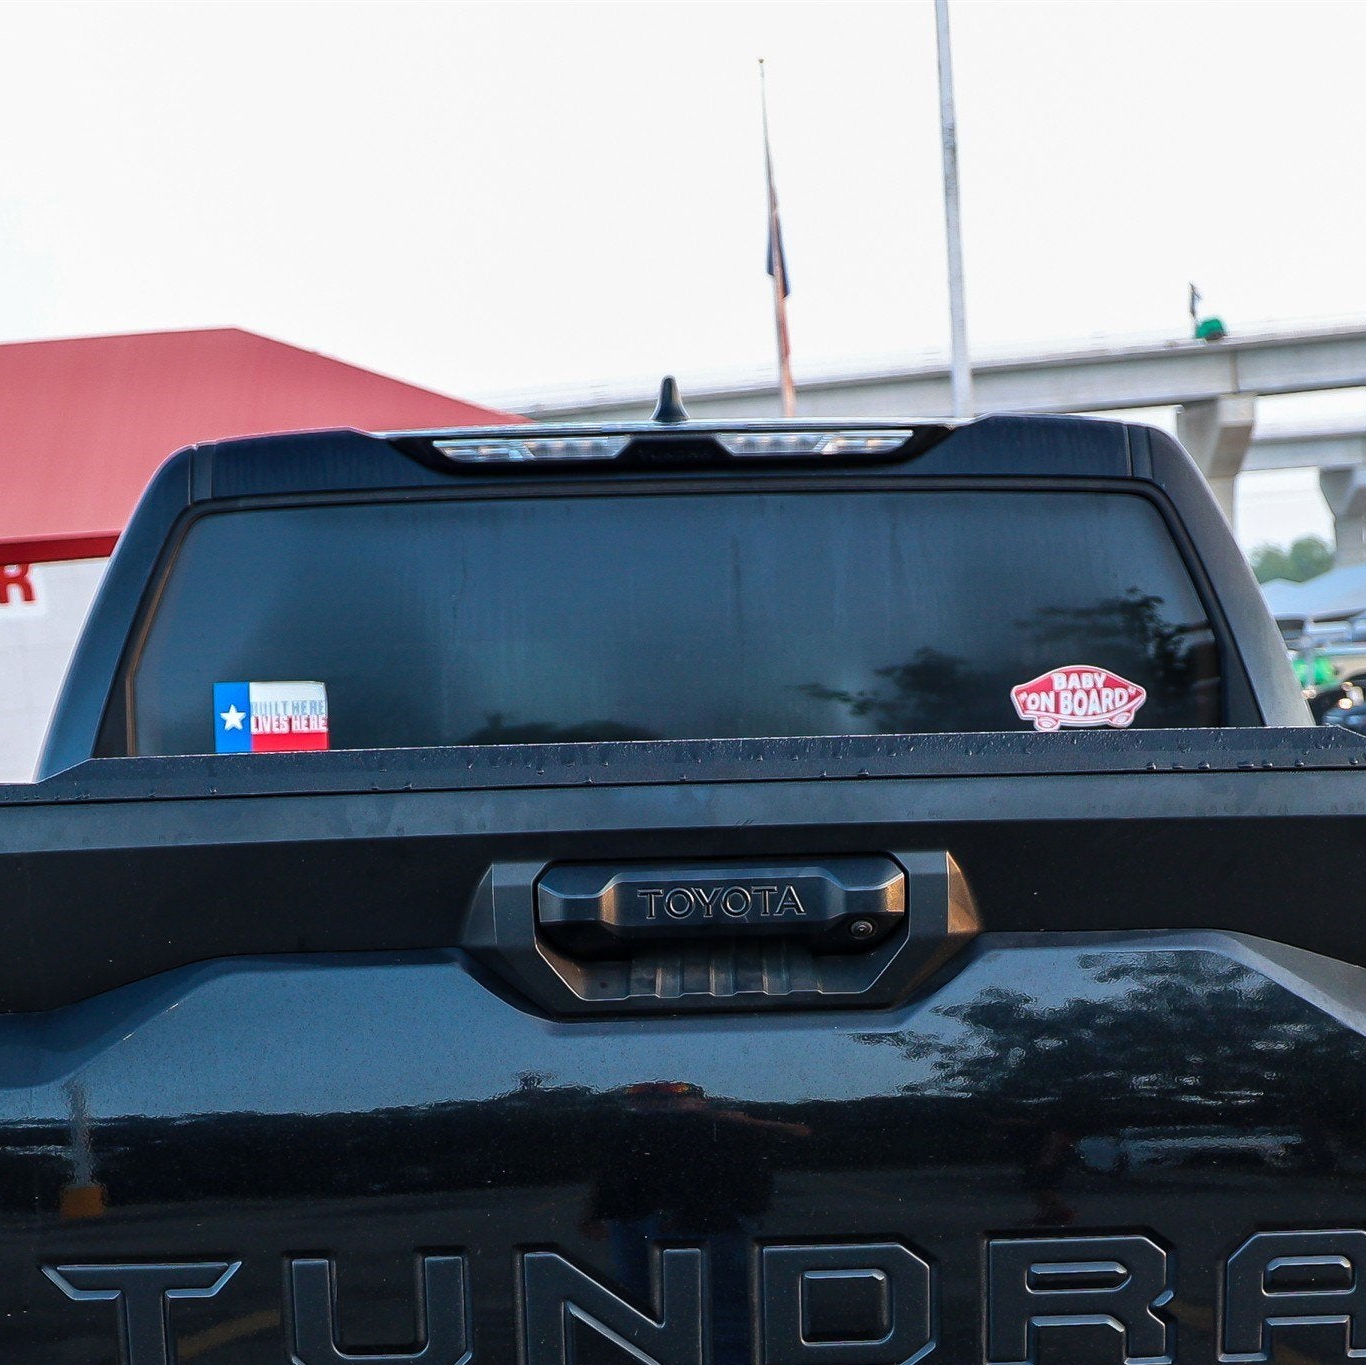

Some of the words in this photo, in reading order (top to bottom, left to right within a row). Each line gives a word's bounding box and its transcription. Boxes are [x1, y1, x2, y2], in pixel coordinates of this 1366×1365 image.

[1050, 672, 1107, 691] BABY
[251, 716, 289, 734] LIVES
[292, 714, 327, 732] HERE
[637, 885, 807, 919] TOYOTA
